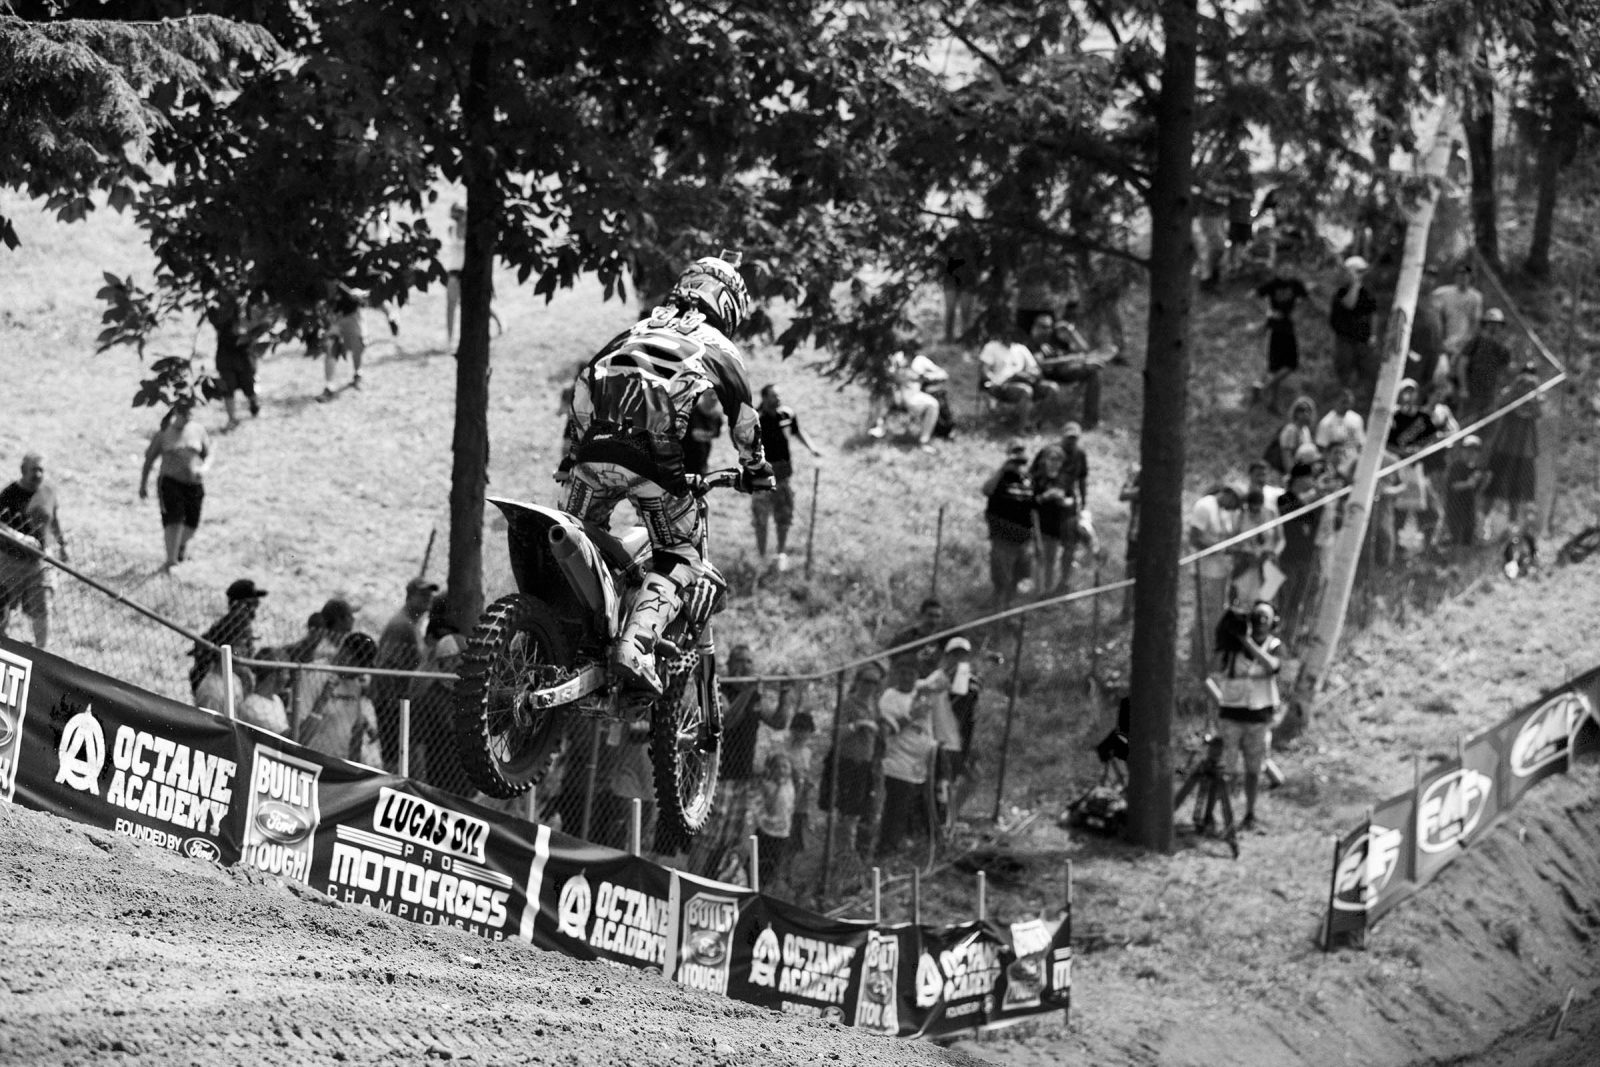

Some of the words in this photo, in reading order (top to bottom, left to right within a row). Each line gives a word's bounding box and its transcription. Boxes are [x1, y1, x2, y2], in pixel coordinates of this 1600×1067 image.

[113, 724, 237, 805] OCTANE
[257, 756, 314, 808] BUILT
[107, 769, 229, 837] ACADEMY
[265, 808, 298, 835] Ford
[379, 794, 447, 846] LUCAS
[450, 817, 484, 858] OIL
[115, 817, 167, 847] FOUNDED
[167, 834, 183, 851] BY
[403, 844, 452, 871] PRO
[248, 841, 307, 881] TOUGH
[329, 842, 510, 929] MOTOCROSS
[327, 884, 504, 943] CHAMPIONSHIP
[688, 899, 734, 933] BUILT
